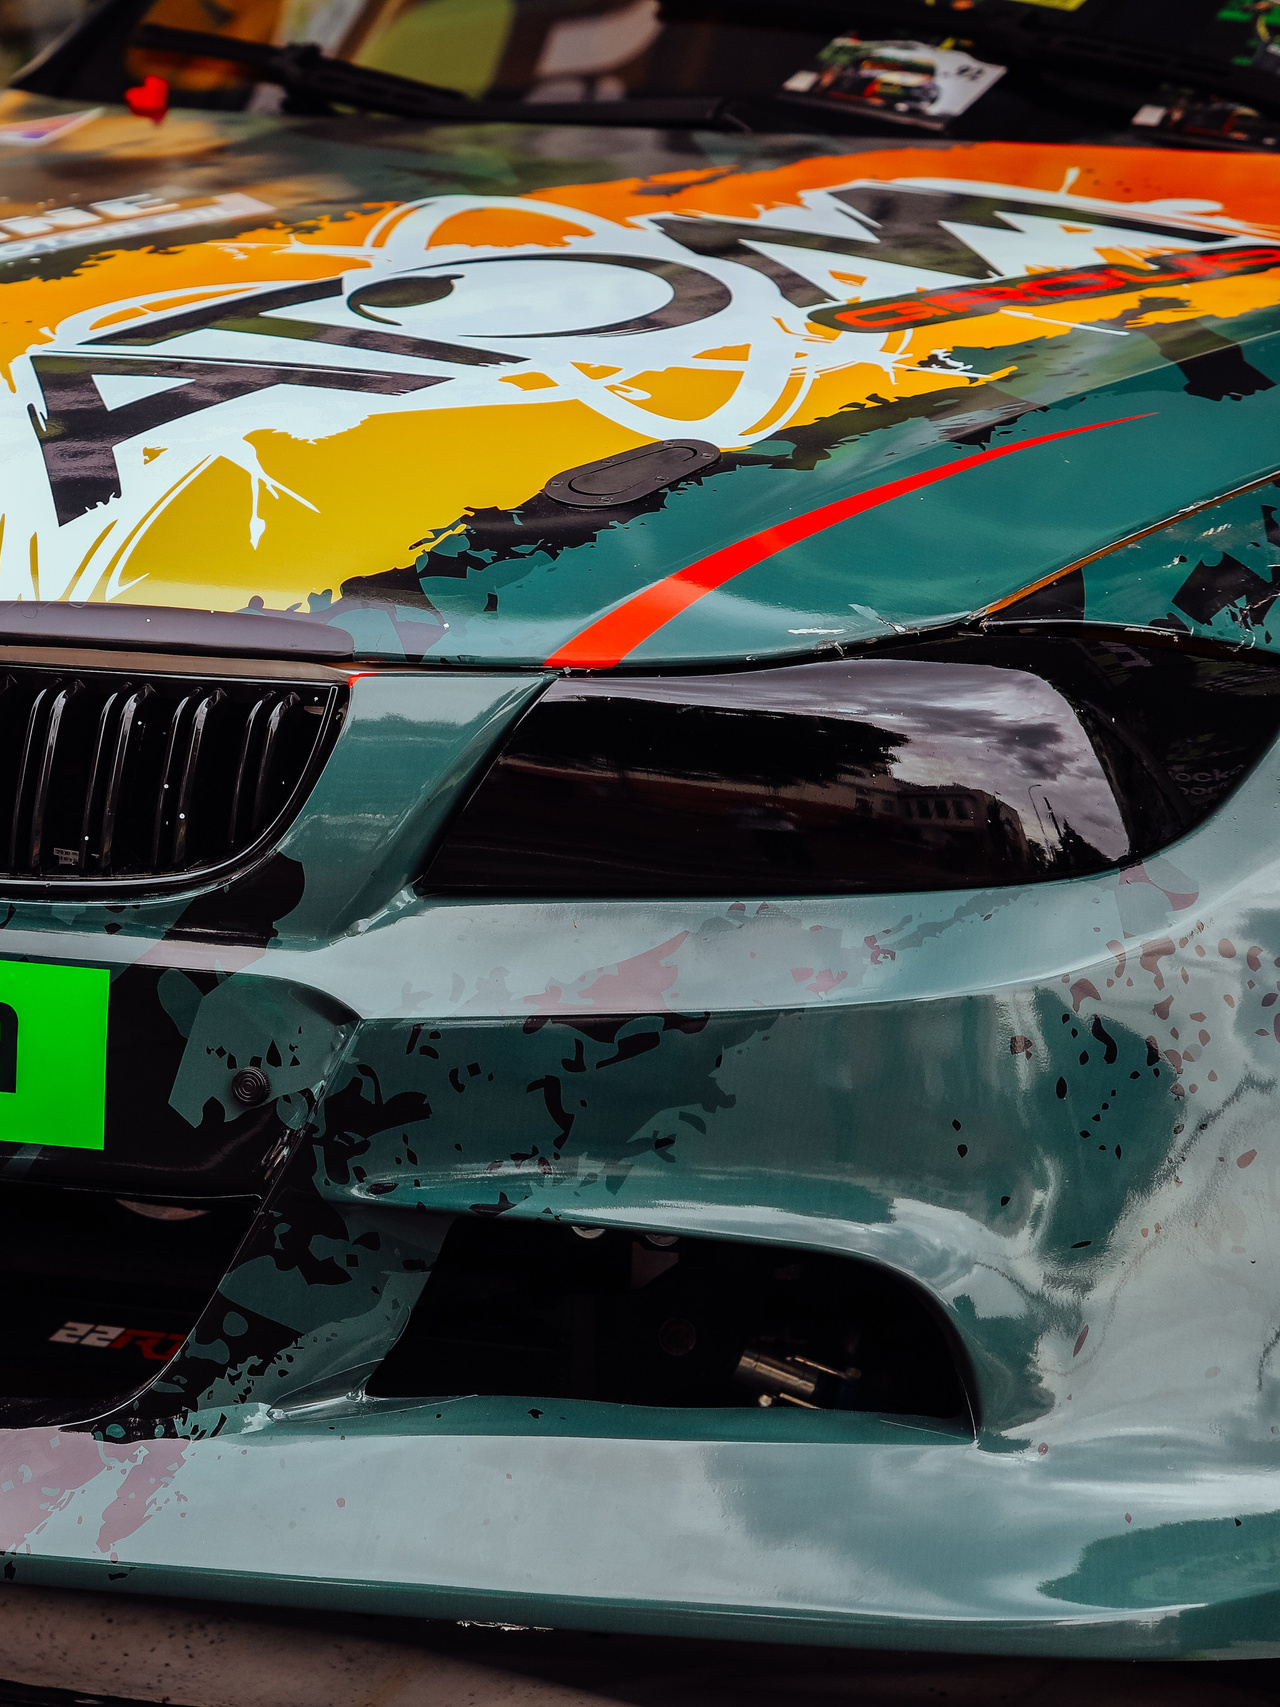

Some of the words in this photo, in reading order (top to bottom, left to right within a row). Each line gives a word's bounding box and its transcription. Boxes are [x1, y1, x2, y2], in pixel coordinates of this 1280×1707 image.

[156, 203, 244, 226] OIL
[832, 246, 1280, 330] GROUP
[28, 179, 1240, 528] ATOM
